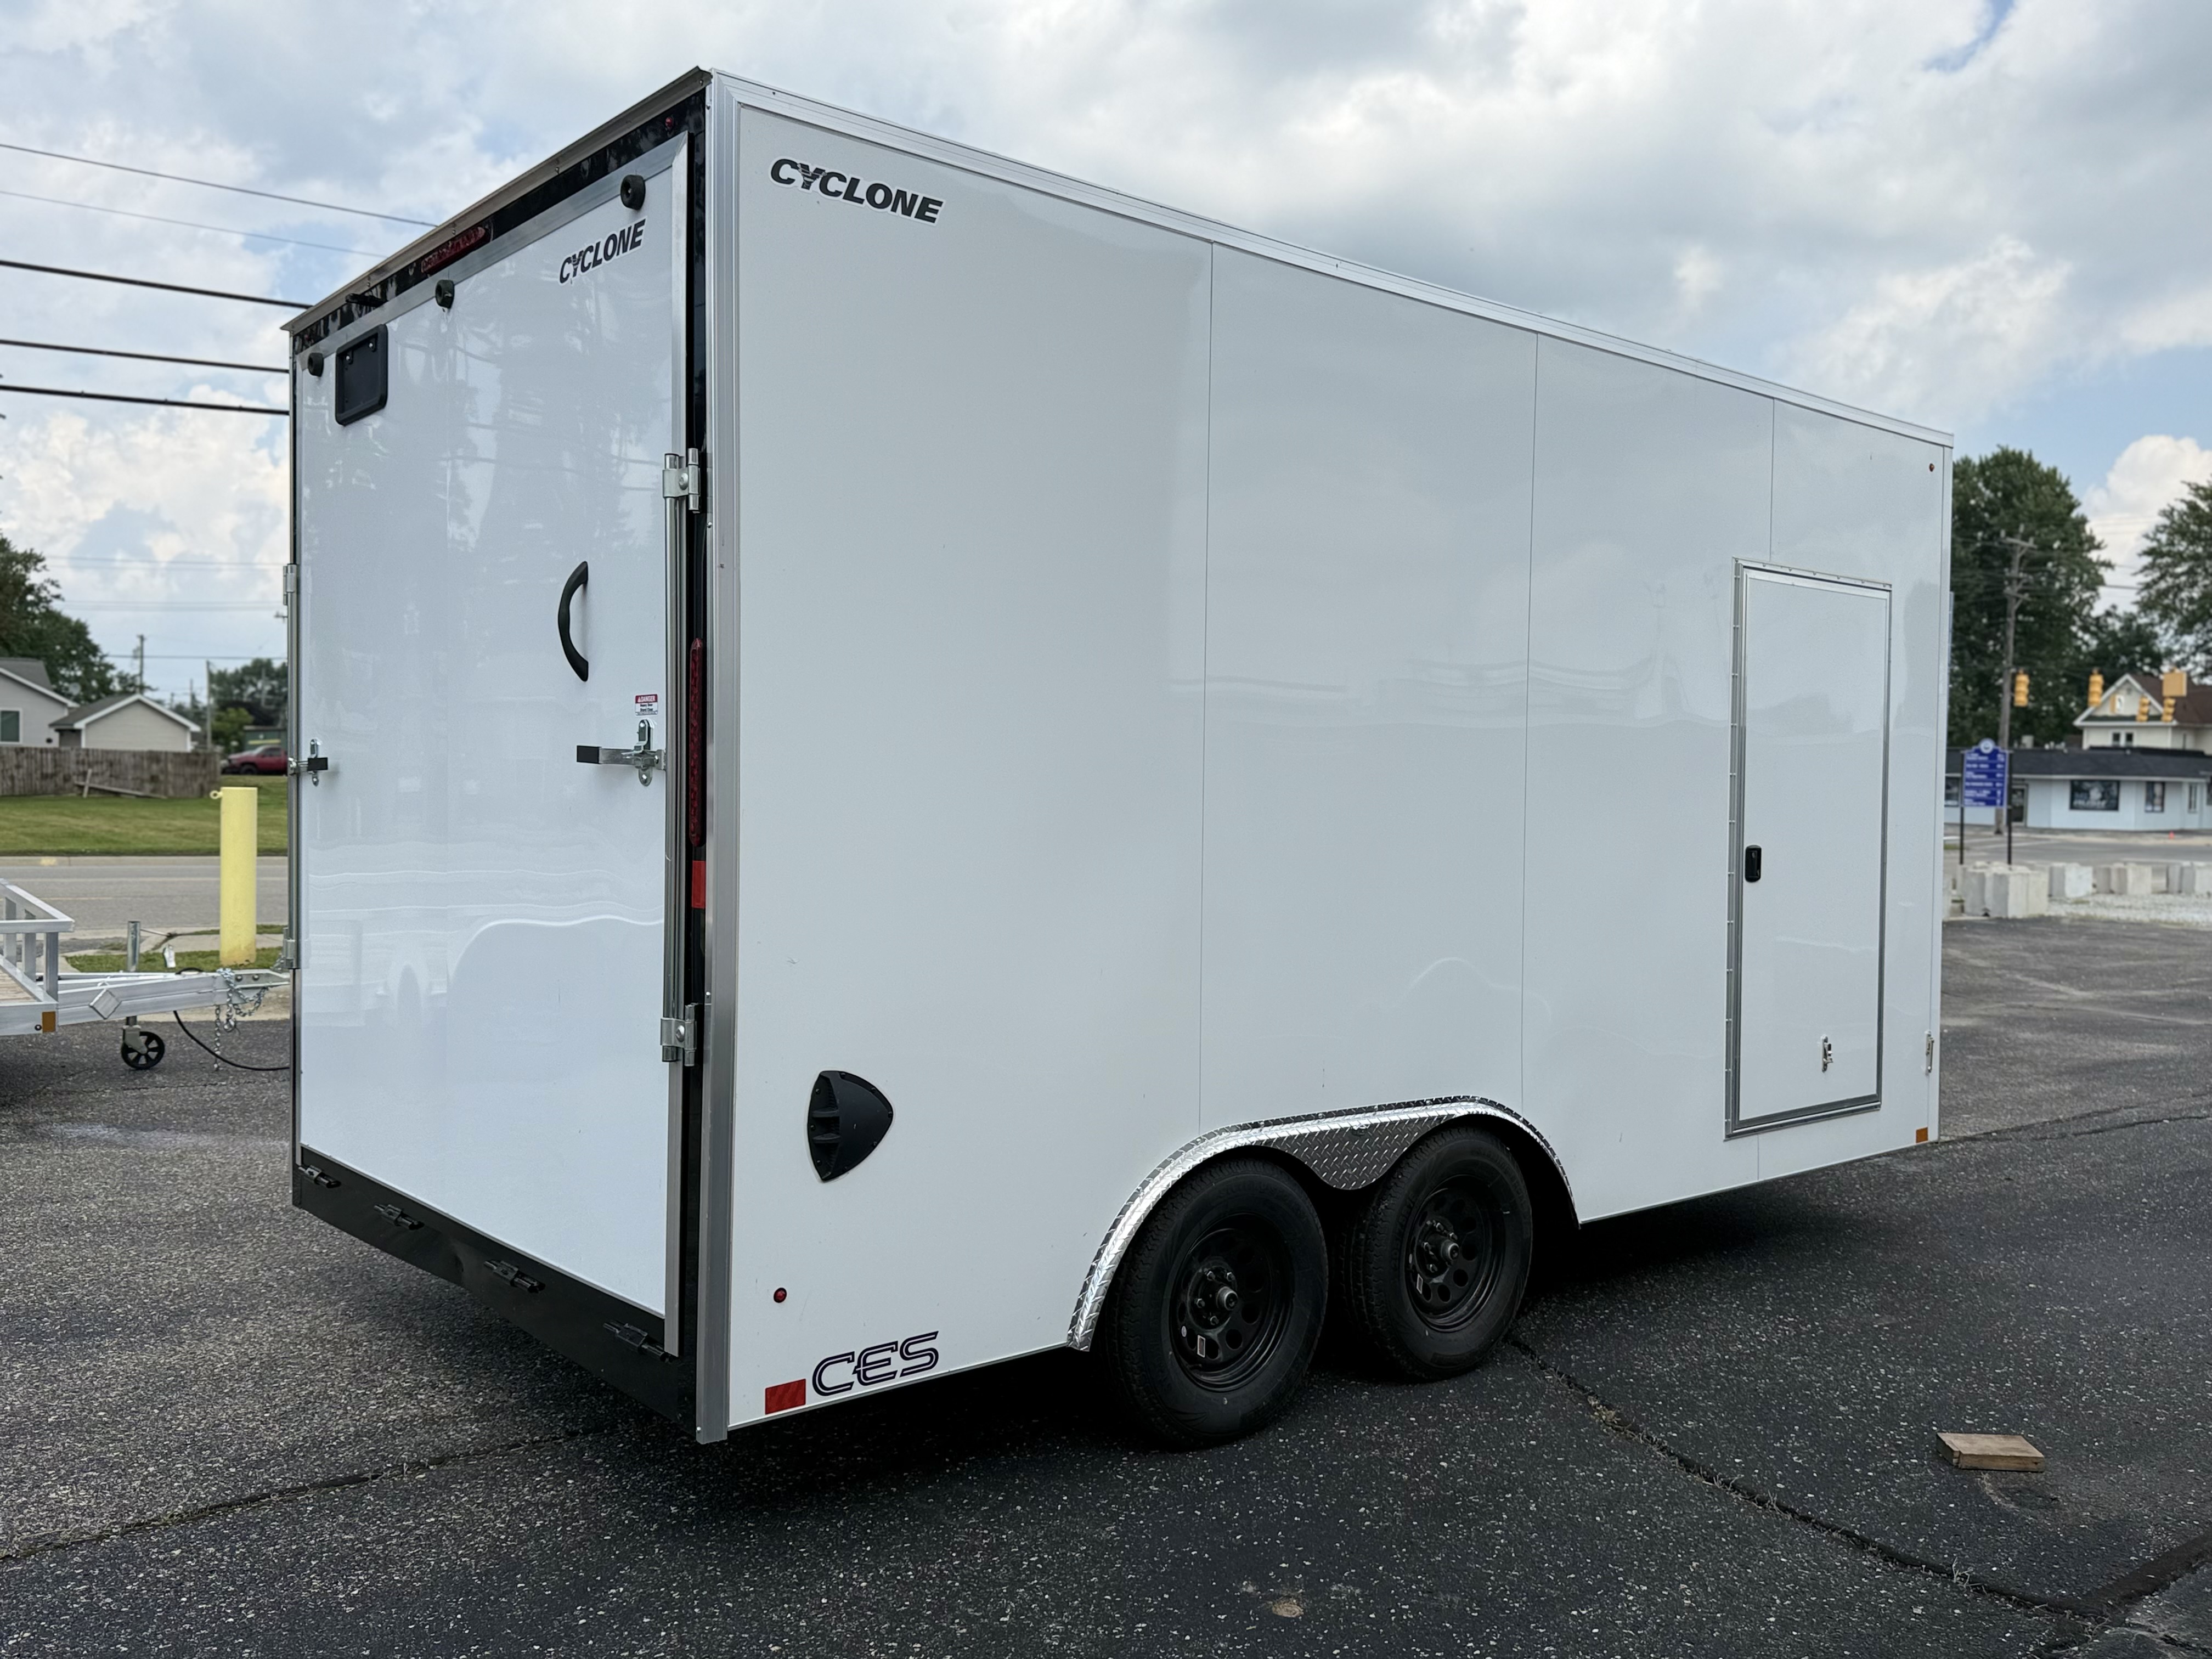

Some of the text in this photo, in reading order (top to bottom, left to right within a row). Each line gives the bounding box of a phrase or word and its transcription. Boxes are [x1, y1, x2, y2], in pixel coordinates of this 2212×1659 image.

[771, 159, 943, 223] CYCLONE
[560, 219, 645, 284] CYCLONE
[812, 1331, 939, 1396] CES
